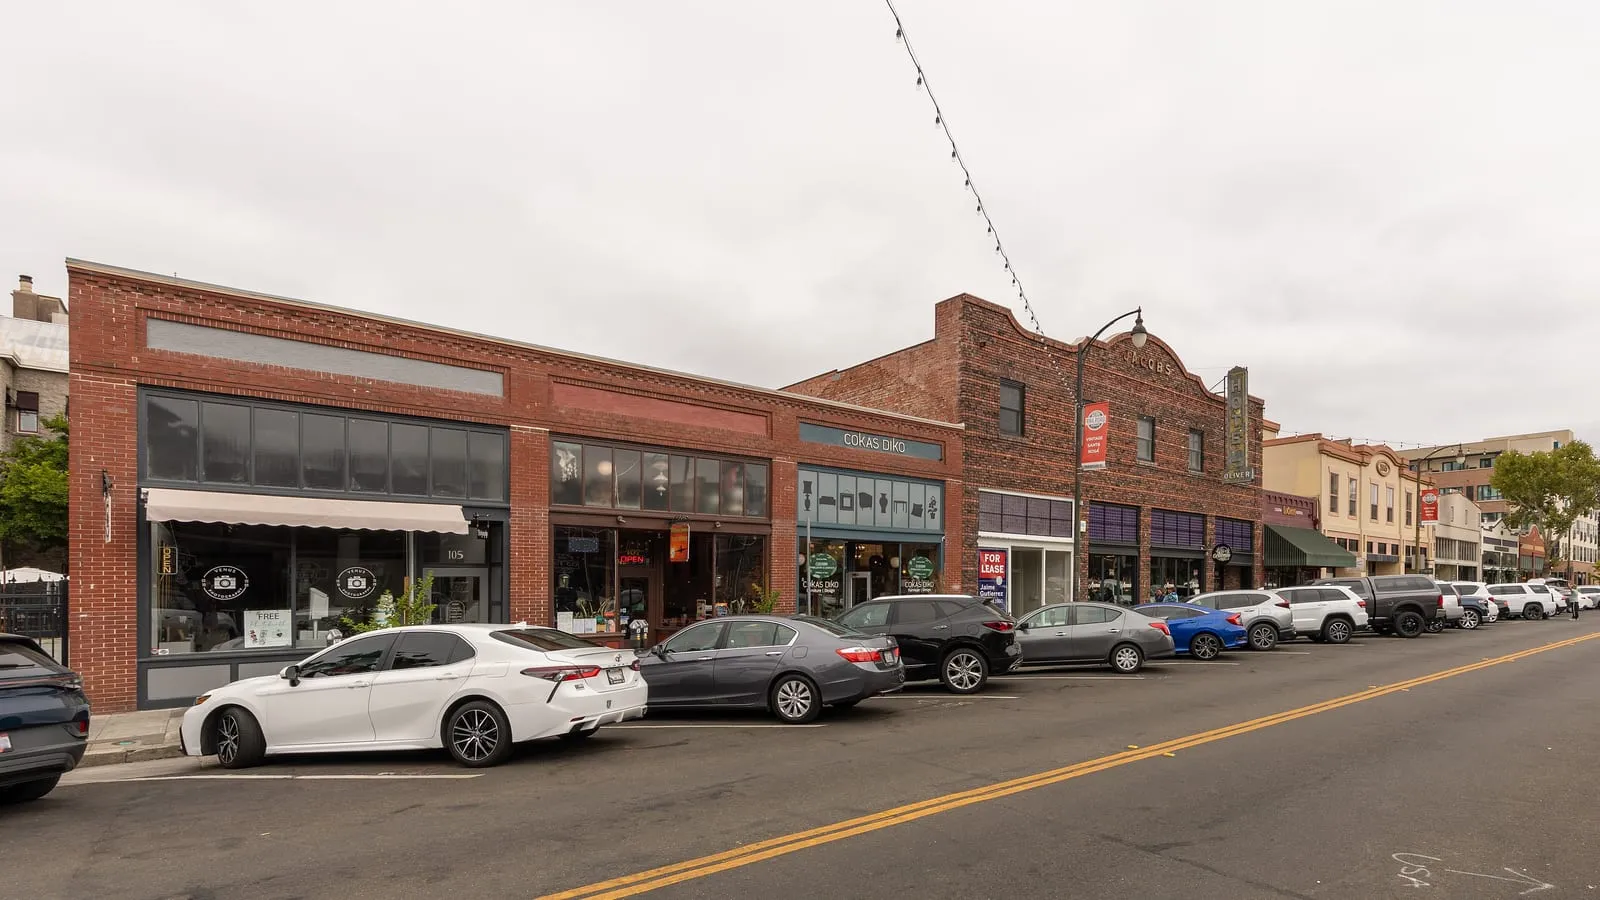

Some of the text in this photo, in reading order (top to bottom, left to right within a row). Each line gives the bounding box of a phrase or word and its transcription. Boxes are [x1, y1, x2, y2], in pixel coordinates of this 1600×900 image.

[1124, 351, 1171, 375] JACOBS
[844, 431, 906, 453] COKAS DIKO
[1224, 470, 1250, 479] OLIVER
[448, 550, 464, 560] 105
[620, 555, 644, 563] OPEN
[984, 553, 1001, 563] FOR
[163, 548, 171, 573] OPEN
[981, 564, 1005, 573] LEASE
[802, 579, 824, 588] CKAS
[905, 580, 921, 588] COKAS
[258, 612, 280, 620] FREE
